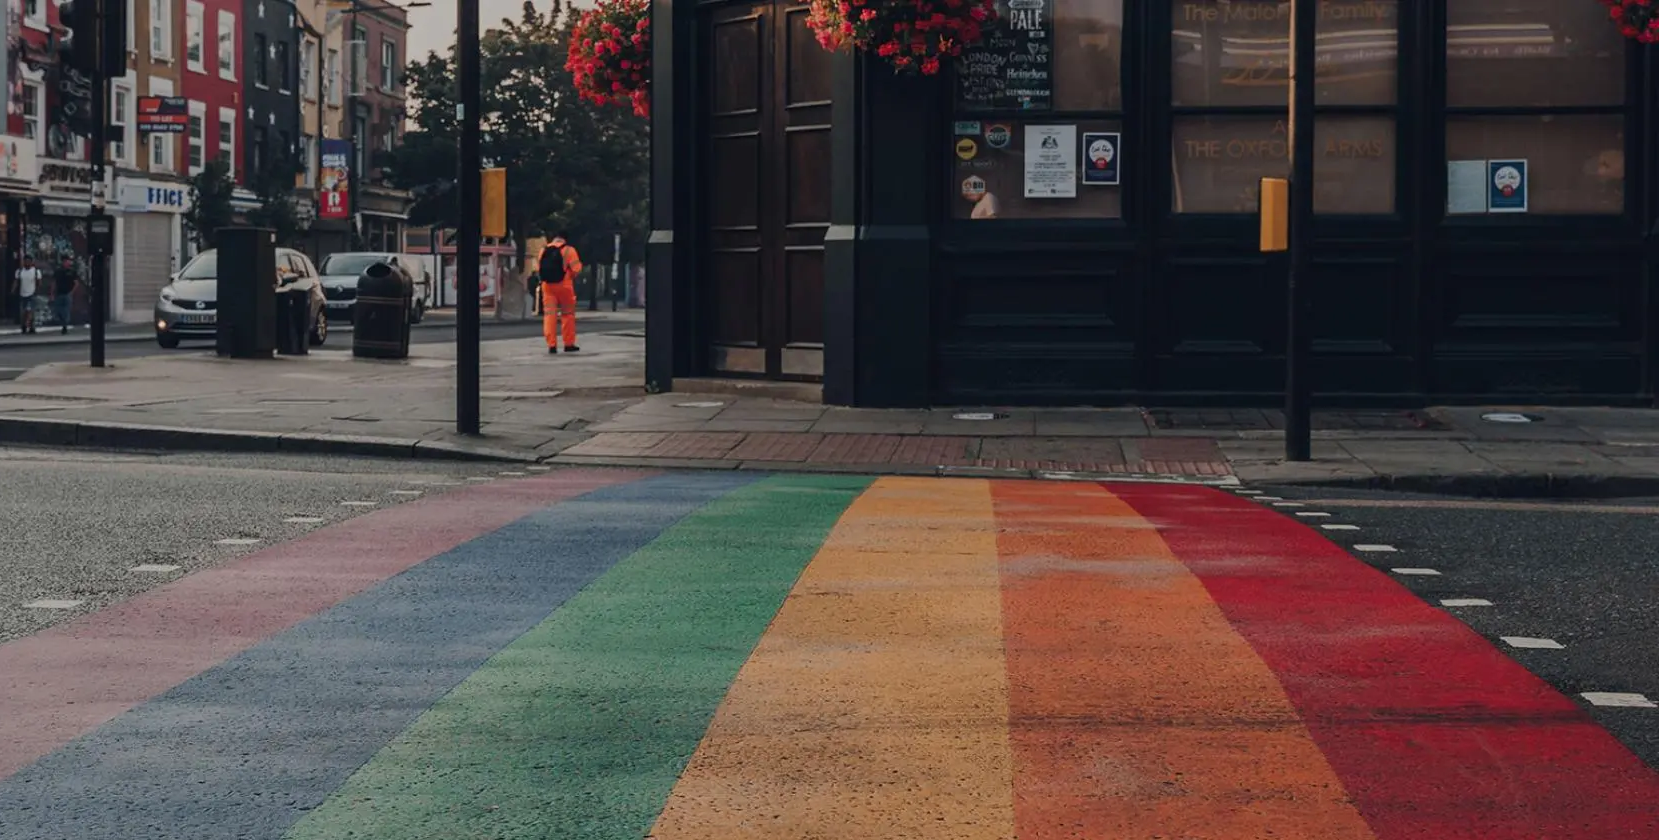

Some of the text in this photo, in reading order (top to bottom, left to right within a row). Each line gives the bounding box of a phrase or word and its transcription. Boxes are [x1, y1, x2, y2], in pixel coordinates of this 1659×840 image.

[1010, 9, 1042, 30] PALE
[1183, 3, 1384, 21] The Malon Family
[961, 52, 1006, 66] LONDON
[970, 63, 998, 75] PRIDE
[1006, 68, 1047, 79] Heineken
[1185, 139, 1384, 158] THE OXFO ARMS
[147, 187, 184, 207] FFICE
